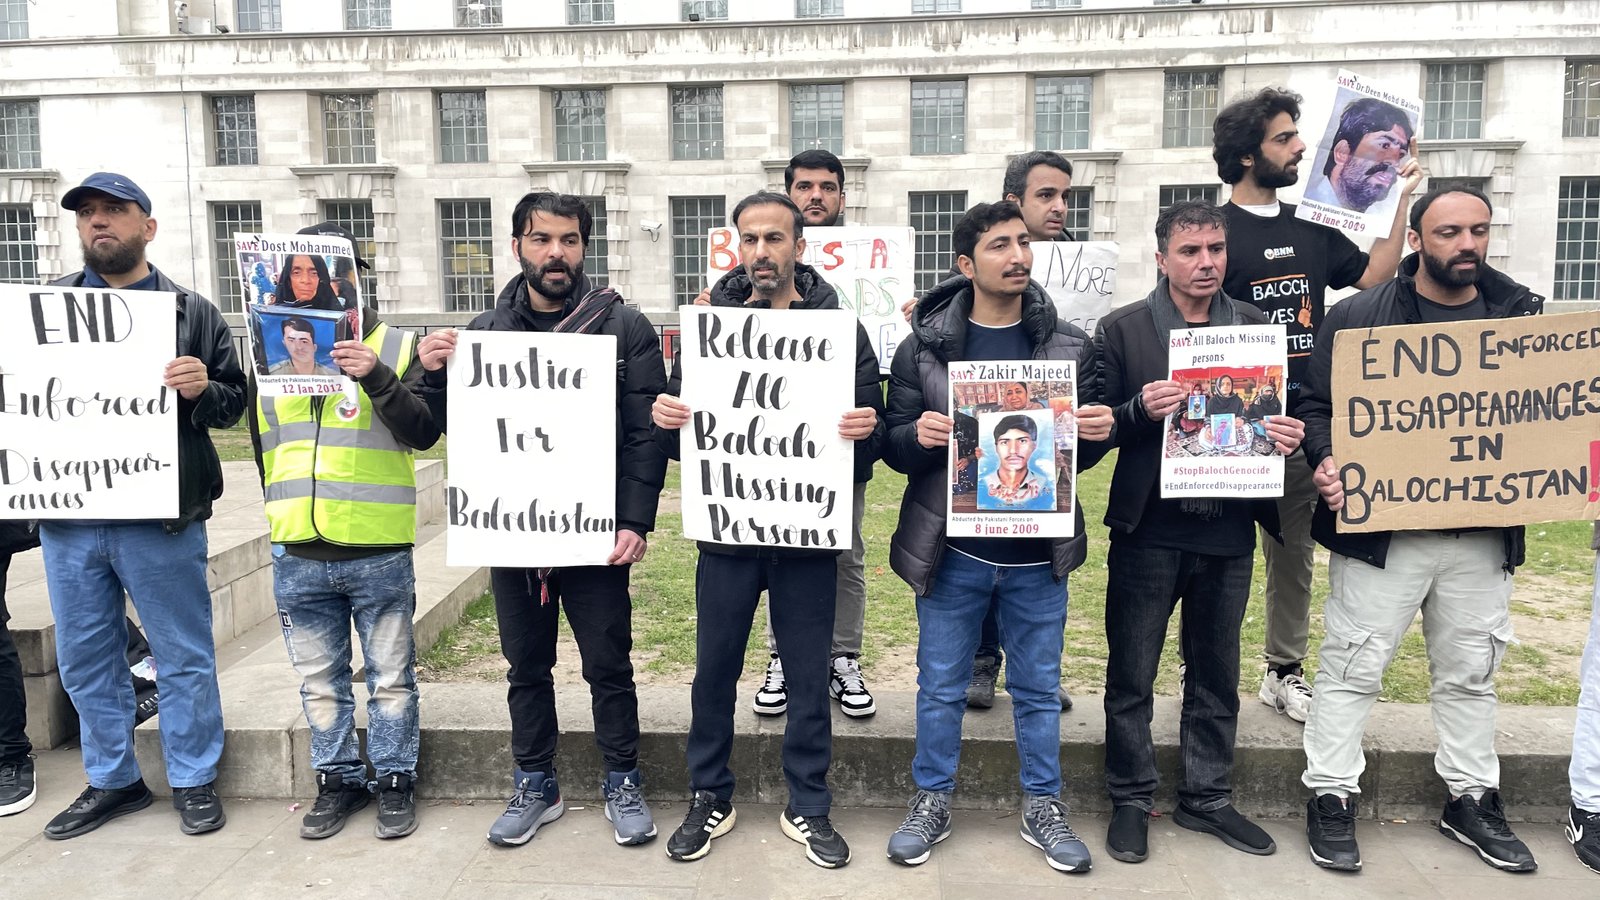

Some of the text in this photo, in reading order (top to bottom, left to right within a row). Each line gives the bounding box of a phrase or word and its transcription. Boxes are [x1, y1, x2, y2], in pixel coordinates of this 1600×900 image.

[1311, 211, 1322, 222] 28
[236, 239, 352, 256] SAVE Dost Mohammed
[1044, 243, 1116, 297] MORE
[1252, 279, 1310, 301] BALOCH
[29, 292, 133, 345] END
[698, 312, 835, 363] Release
[1170, 333, 1276, 348] SAVE All Baloch Missing
[1192, 353, 1225, 366] persons
[1362, 333, 1462, 380] END
[460, 342, 588, 390] Justice
[950, 363, 1072, 382] SAVE Zakir Majeed
[0, 373, 171, 422] Enforced
[282, 383, 343, 395] 12 Jan 2012
[732, 370, 791, 411] All
[1348, 376, 1600, 438] DISAPPEARANCES
[693, 410, 826, 459] Baloch
[1449, 432, 1503, 462] IN
[0, 448, 171, 492] Disappear-
[700, 459, 836, 519] Missing
[1164, 481, 1282, 493] #EndEnforcedDisappearances
[1173, 466, 1271, 477] #StopBalochGenocide
[8, 491, 84, 511] ances
[448, 486, 615, 534] Balochistan
[708, 503, 839, 548] Persons
[975, 523, 1039, 536] 8 june 2009
